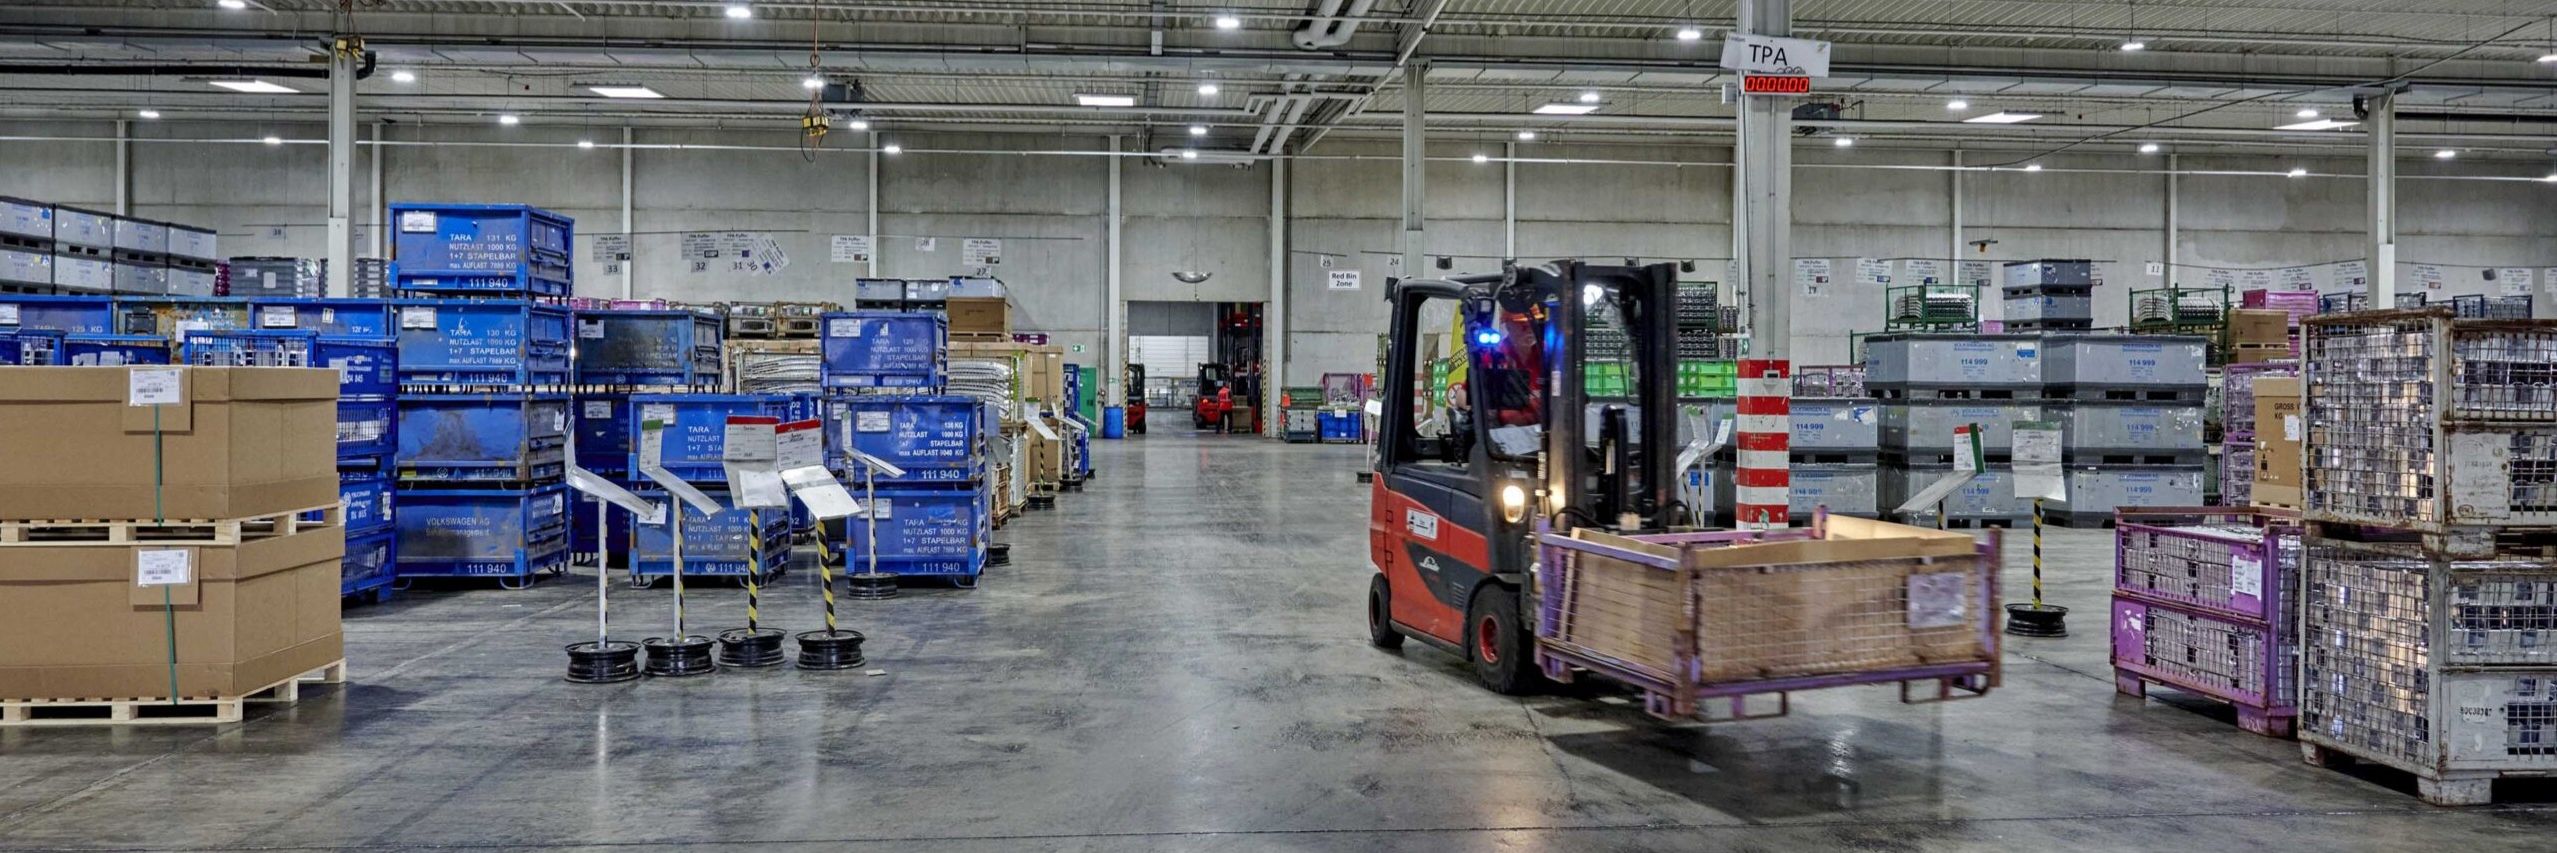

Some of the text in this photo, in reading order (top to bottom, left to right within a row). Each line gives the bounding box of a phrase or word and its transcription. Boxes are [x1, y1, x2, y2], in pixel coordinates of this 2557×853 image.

[1748, 44, 1788, 66] TPA
[449, 243, 517, 251] NUTZLAST 1000 KG
[696, 261, 706, 271] 32
[1390, 258, 1399, 266] 24
[608, 264, 618, 273] 33
[1332, 272, 1357, 280] Red Bin
[469, 278, 508, 288] 111 940
[449, 338, 483, 346] NUTZLAST
[504, 338, 517, 346] KG
[488, 373, 508, 383] 940
[2274, 412, 2283, 420] KG
[921, 470, 960, 479] 111 940
[426, 517, 477, 526] VOLKSWAGEN
[688, 525, 722, 533] NUTZLAST
[467, 564, 507, 574] 111 940
[923, 563, 960, 572] 111 940
